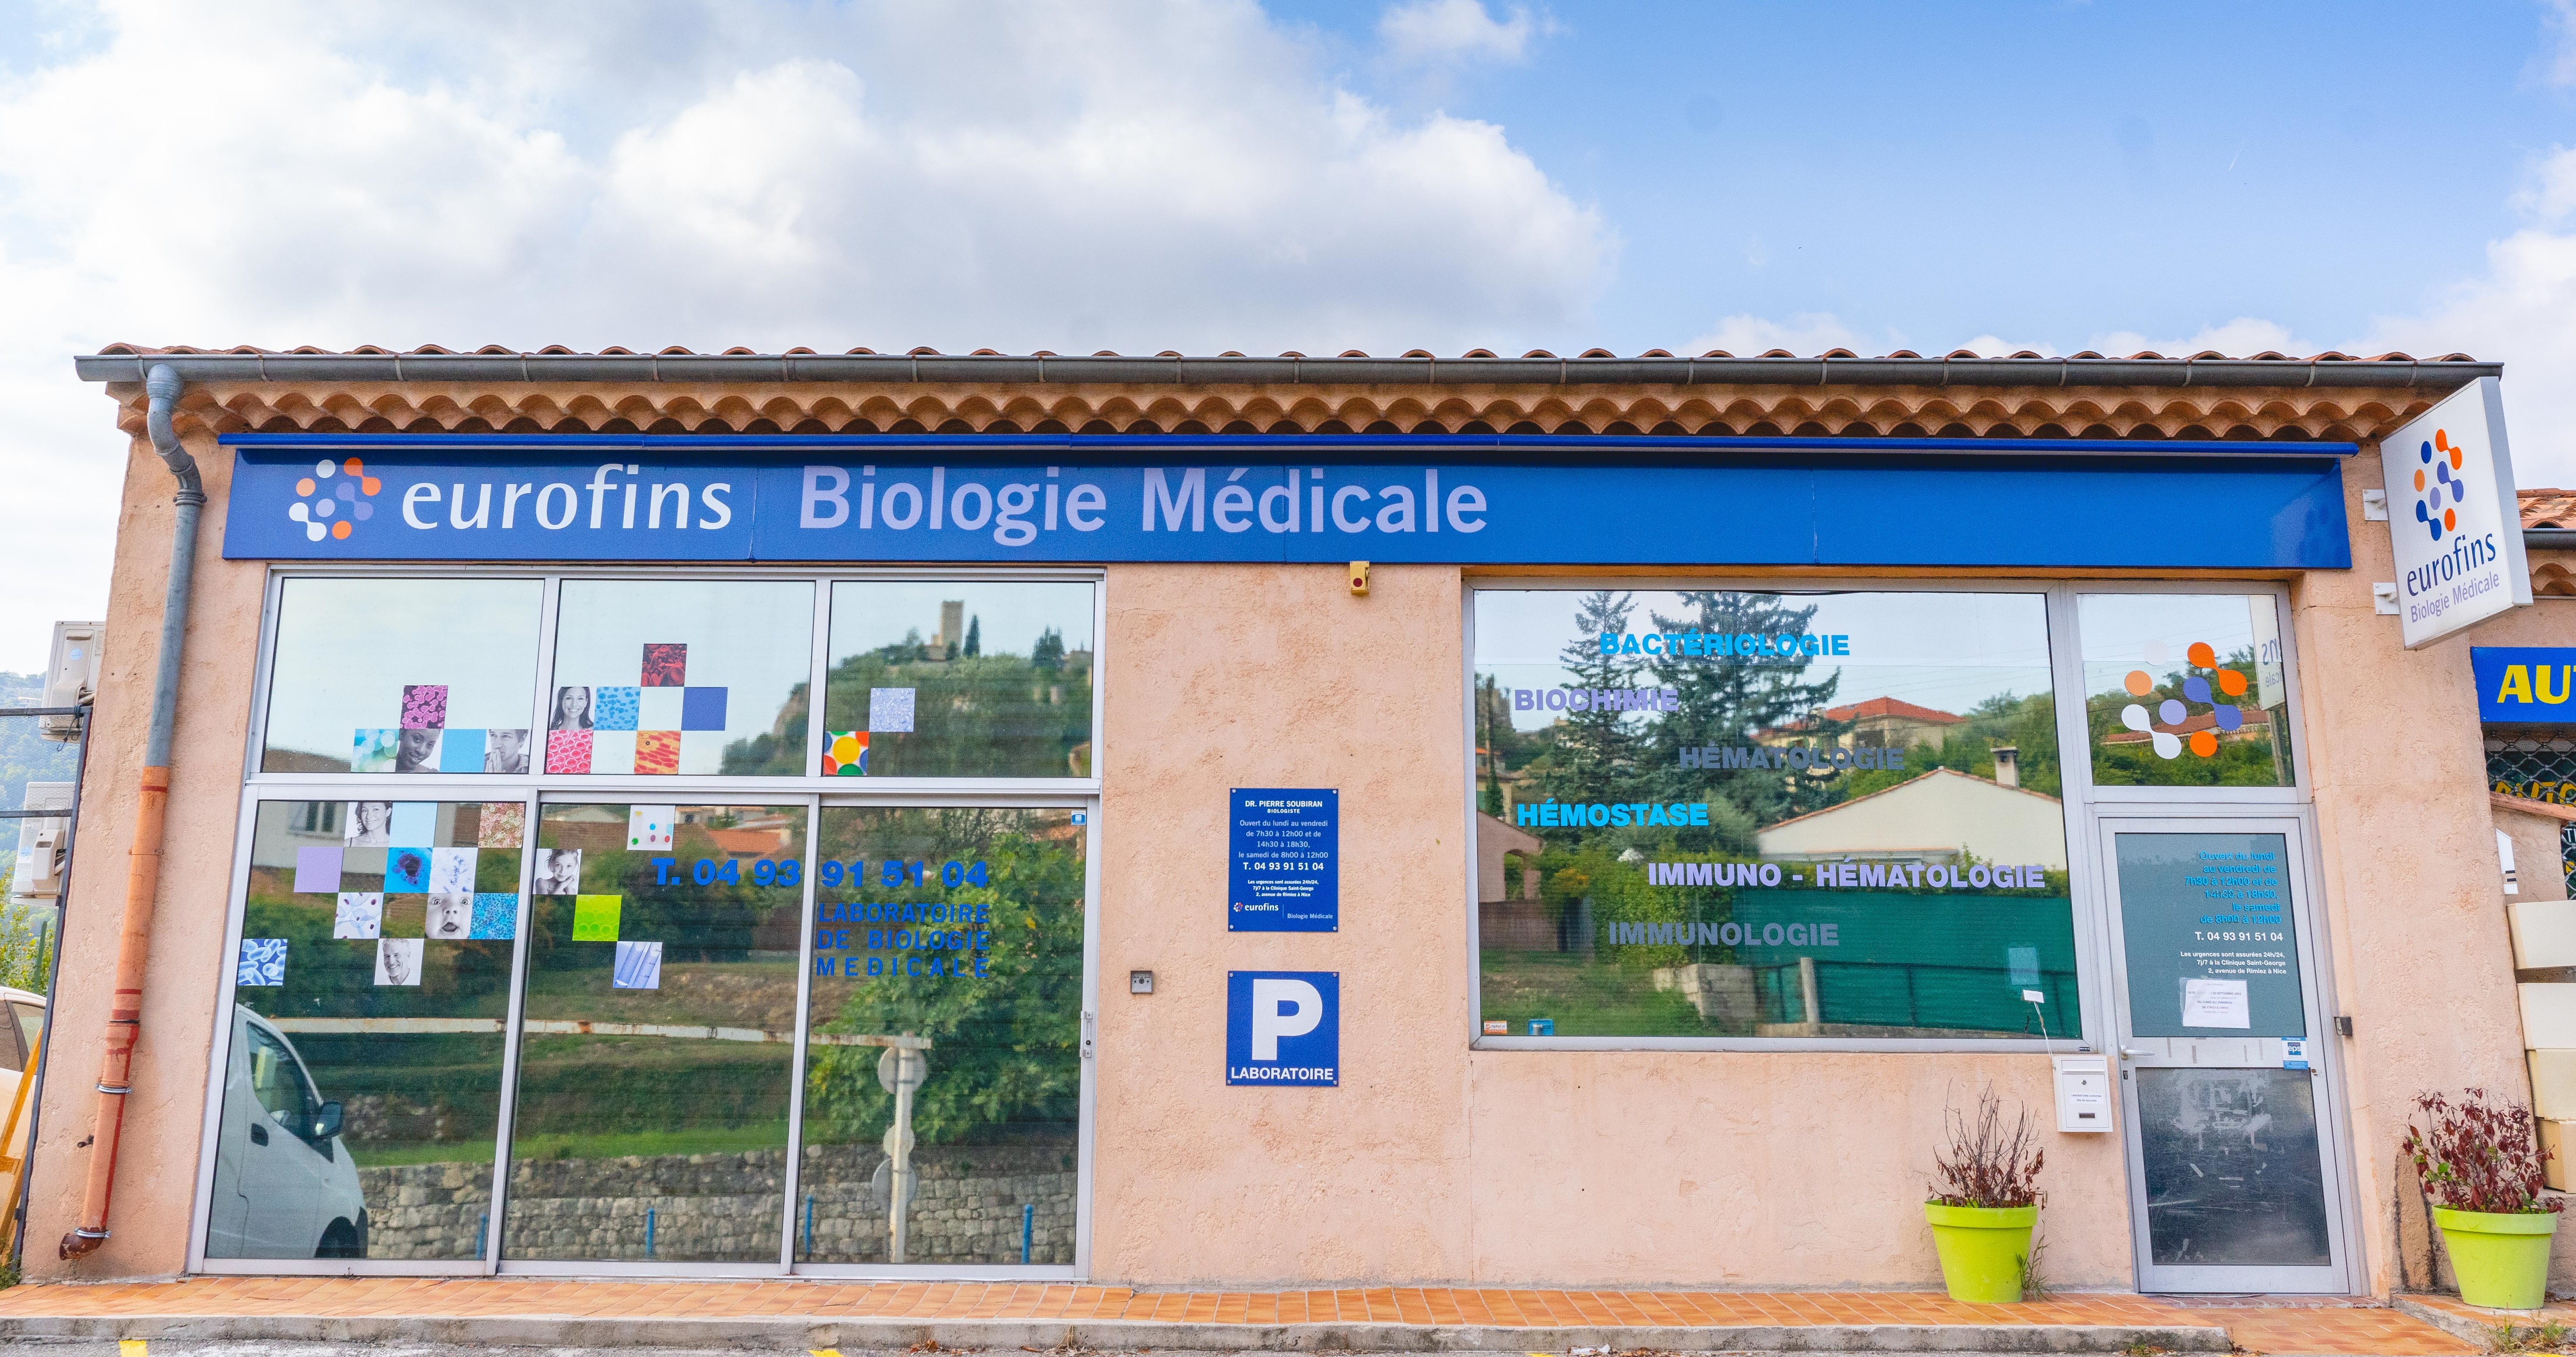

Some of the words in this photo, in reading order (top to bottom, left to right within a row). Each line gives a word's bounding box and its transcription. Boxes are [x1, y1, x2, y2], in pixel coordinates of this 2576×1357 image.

[402, 463, 732, 530] eurofins
[800, 465, 1106, 547] Biologie
[1142, 467, 1487, 533] Médicale
[2407, 533, 2496, 596] eurofins
[2411, 593, 2449, 623] Biologie
[2452, 571, 2499, 605] Médicale
[1600, 629, 1849, 656] BACTÉRIOLOGIE
[2497, 665, 2576, 704] AU
[1515, 689, 1679, 711] BIOCHIMIE
[1679, 742, 1904, 770] HÉMATOLOGIE
[1517, 798, 1709, 827] HÉMOSTASE
[2200, 851, 2232, 860] Ouvert
[2235, 852, 2248, 860] du
[2251, 852, 2275, 860] lundi
[651, 857, 680, 885] T.
[693, 858, 740, 886] 04
[754, 860, 800, 887] 93
[821, 861, 863, 887] 91
[881, 861, 923, 888] 51
[942, 861, 989, 888] 04
[1648, 862, 1782, 886] IMMUNO
[1817, 858, 2045, 888] HÉMATOLOGIE
[2218, 864, 2261, 873] vendredi
[2264, 865, 2276, 873] de
[2184, 877, 2208, 886] 7h30
[2211, 877, 2217, 886] à
[2220, 877, 2249, 886] 12h00
[819, 903, 989, 923] LABORATOIRE
[1244, 903, 1279, 911] eurofins
[2232, 902, 2242, 911] le
[2244, 903, 2280, 912] samedi
[2200, 915, 2213, 923] de
[2243, 915, 2249, 923] à
[2252, 916, 2281, 924] 12h00
[818, 930, 850, 950] DE
[868, 930, 990, 951] BIOLOGIE
[1609, 922, 1839, 947] IMMUNOLOGIE
[2194, 932, 2204, 941] T.
[2207, 932, 2220, 941] 04
[2223, 932, 2235, 941] 93
[2238, 932, 2250, 941] 91
[2254, 932, 2266, 941] 51
[2270, 933, 2283, 941] 04
[817, 957, 989, 978] MEDICALE
[1252, 979, 1323, 1060] P
[1231, 1067, 1333, 1080] LABORATOIRE
